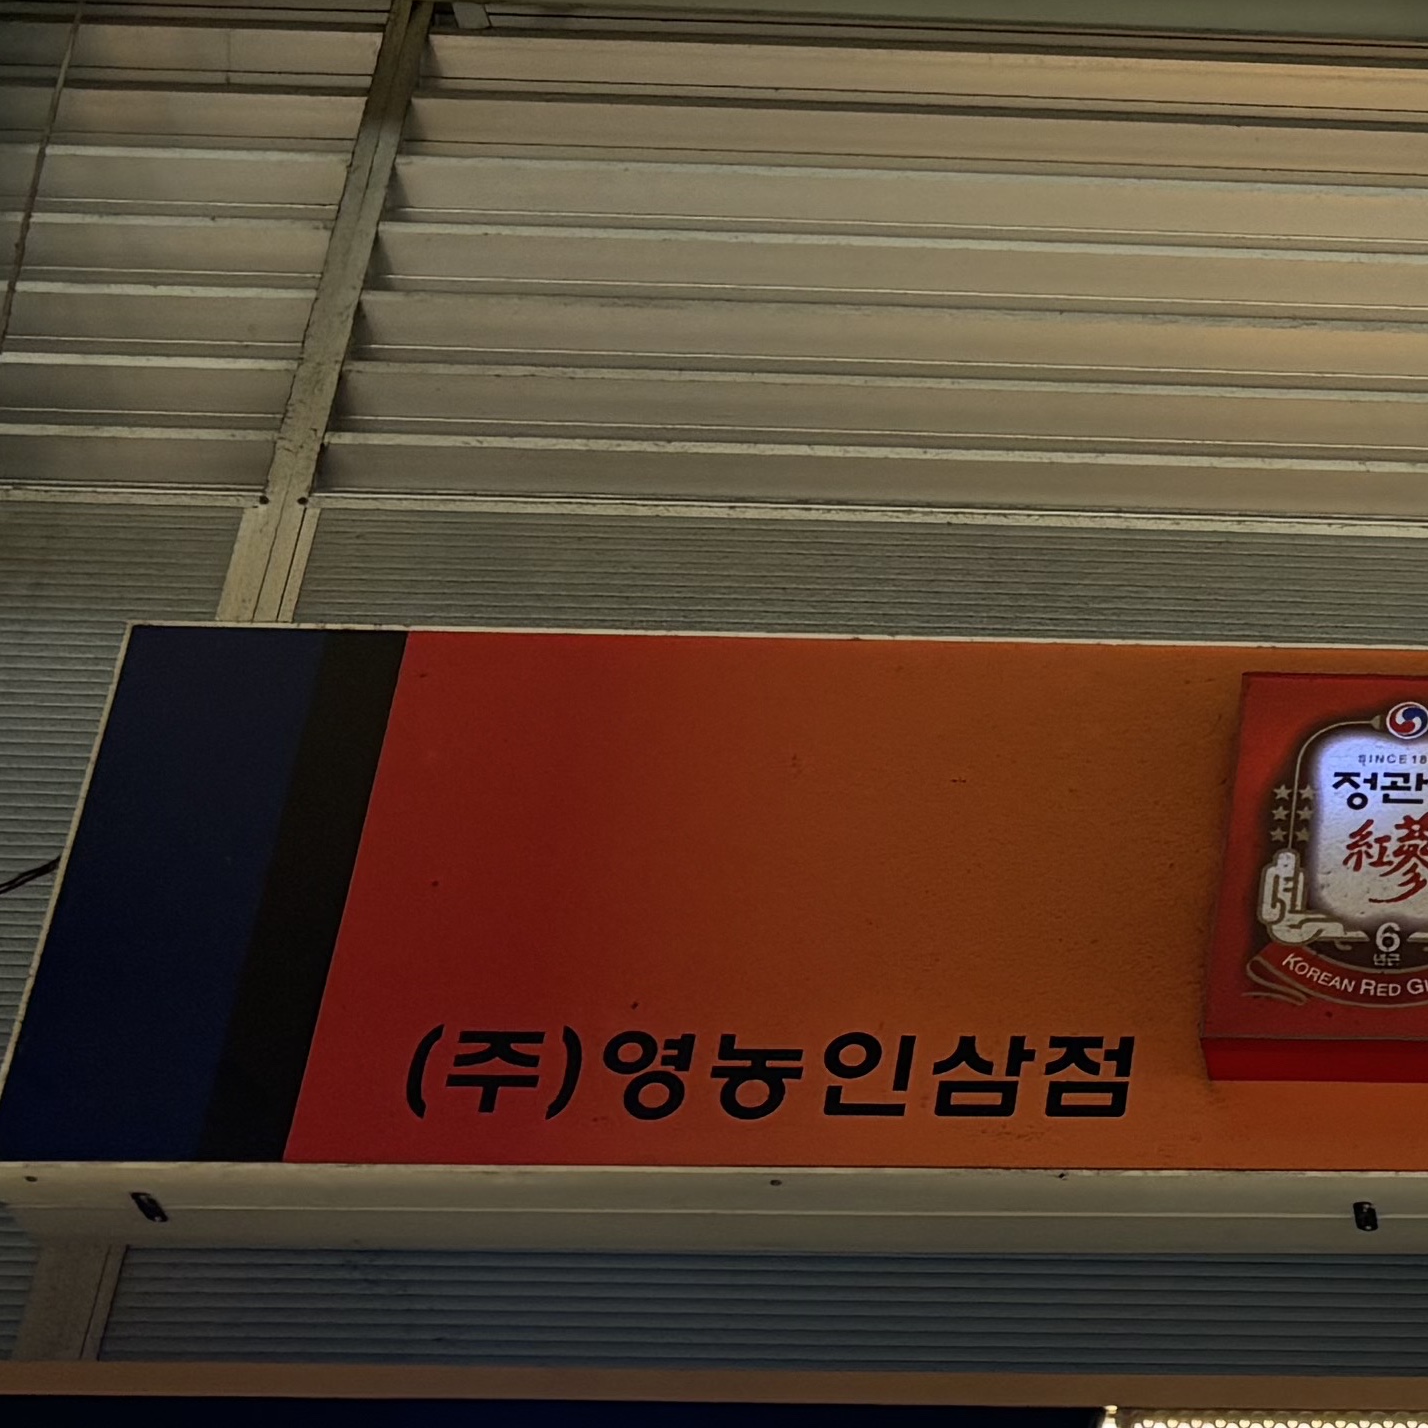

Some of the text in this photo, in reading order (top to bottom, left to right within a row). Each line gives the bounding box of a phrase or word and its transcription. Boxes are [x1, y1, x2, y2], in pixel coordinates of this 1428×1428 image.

[1358, 754, 1407, 766] SINCE
[1376, 922, 1400, 952] 6
[1282, 953, 1355, 993] KOREAN
[1360, 979, 1401, 997] RED
[406, 1023, 1136, 1121] (주)영농인삼점
